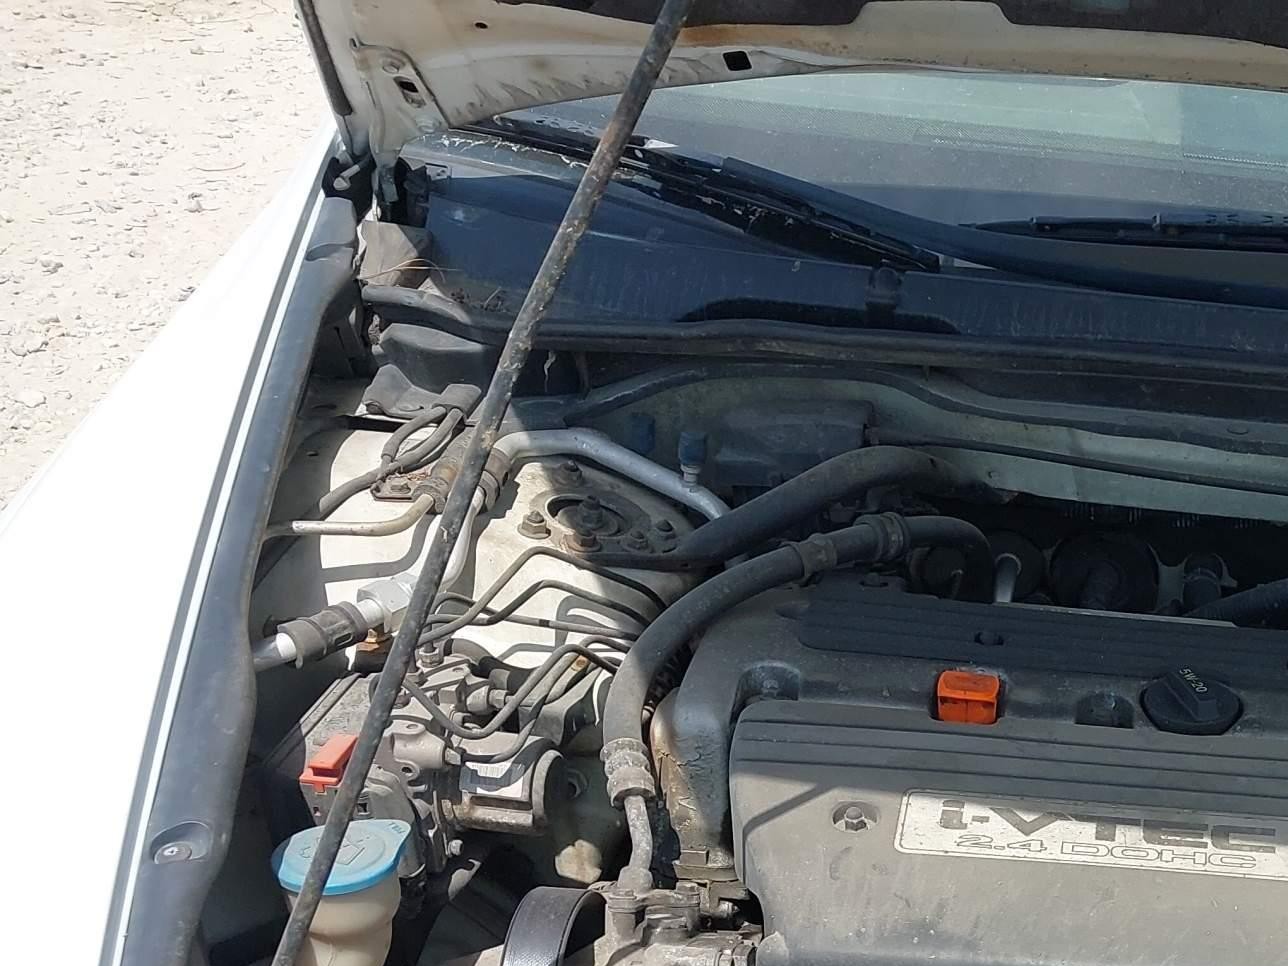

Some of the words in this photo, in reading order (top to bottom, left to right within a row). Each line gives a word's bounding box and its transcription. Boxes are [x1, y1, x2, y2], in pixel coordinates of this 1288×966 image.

[1179, 667, 1208, 693] 5W-20
[939, 799, 1277, 854] i-VTEC
[957, 835, 1048, 853] 2.4
[1060, 841, 1258, 869] DOHC
